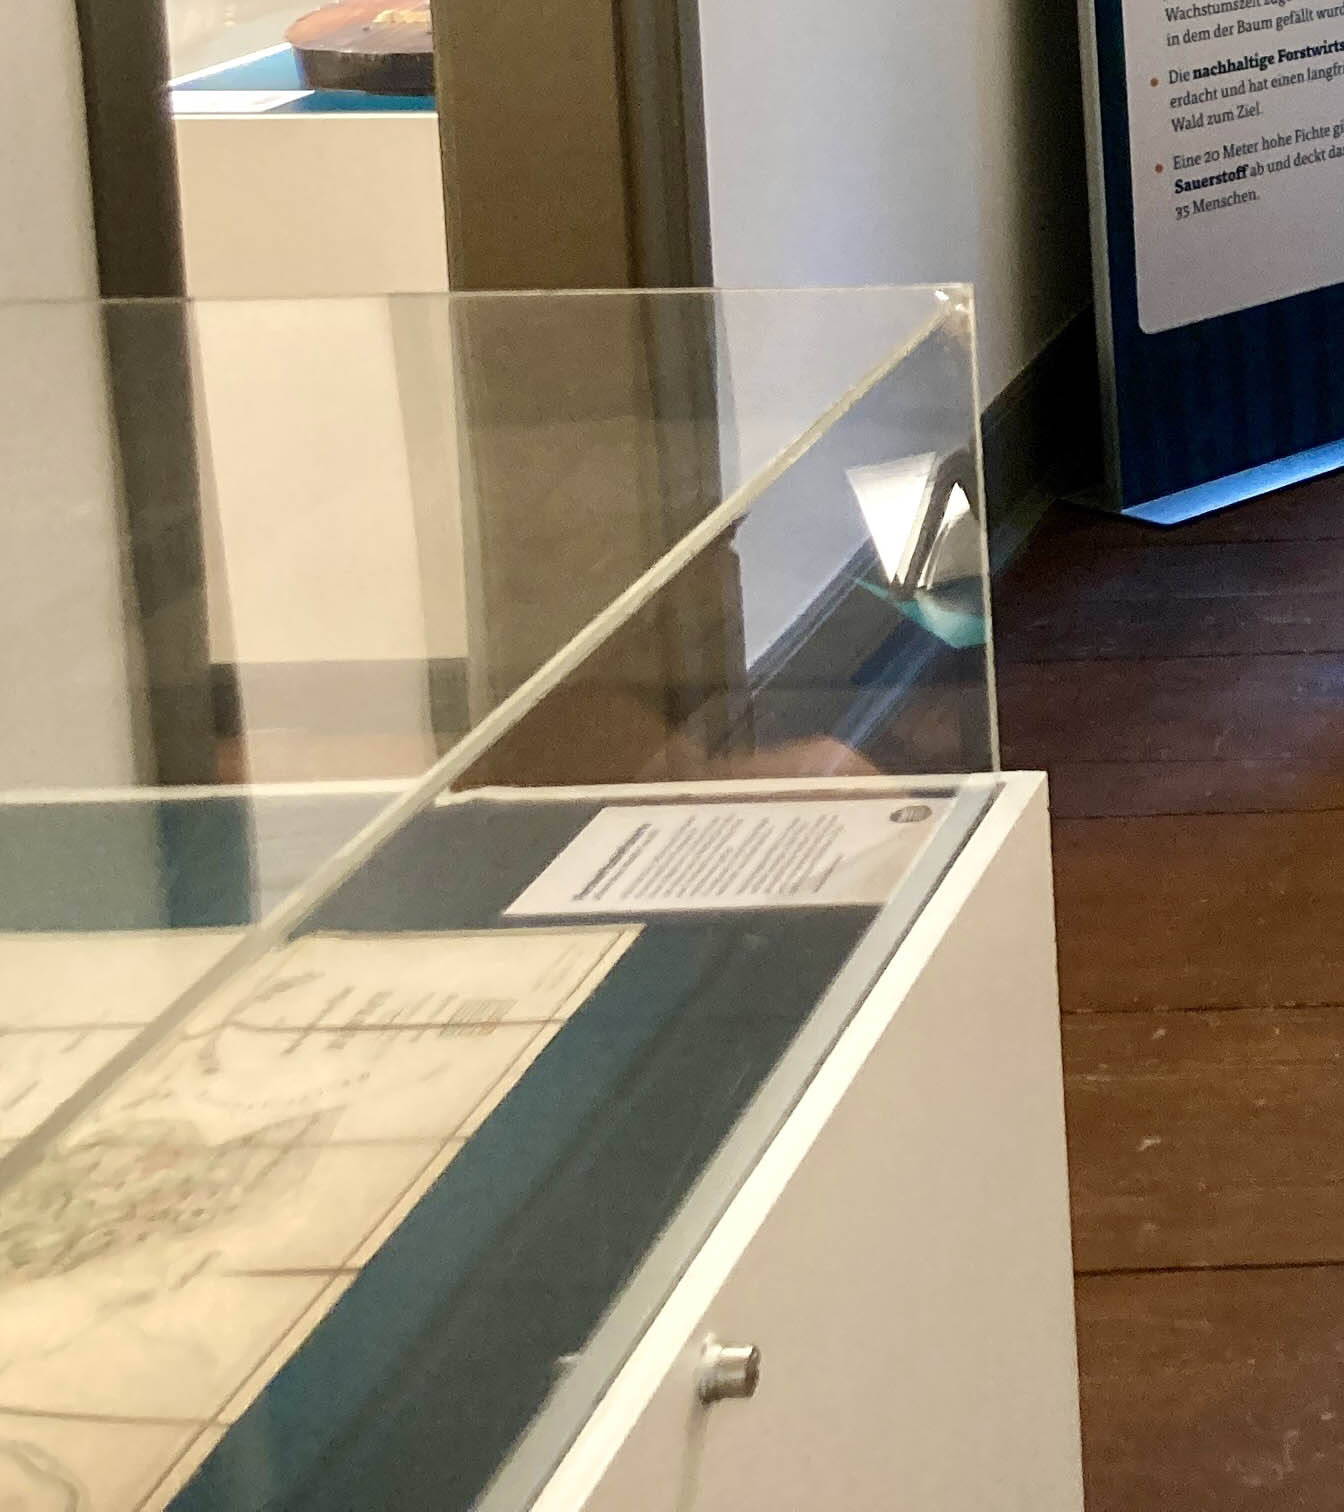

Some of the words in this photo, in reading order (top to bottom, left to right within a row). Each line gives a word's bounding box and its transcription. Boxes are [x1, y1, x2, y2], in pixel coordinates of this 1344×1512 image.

[1167, 33, 1179, 46] in
[1183, 29, 1210, 44] dem
[1214, 24, 1234, 40] der
[1237, 19, 1272, 34] Baum
[1169, 70, 1190, 85] Die
[1193, 52, 1274, 80] nachhaltige
[1170, 89, 1217, 108] erdacht
[1221, 81, 1246, 98] und
[1249, 79, 1269, 93] hat
[1272, 73, 1304, 87] einen
[1172, 114, 1204, 132] Wald
[1207, 109, 1234, 125] zum
[1173, 155, 1201, 170] Eine
[1223, 142, 1259, 159] Meter
[1262, 135, 1292, 150] hohe
[1295, 126, 1330, 144] Fichte
[1174, 164, 1249, 193] Sauerstoff
[1250, 163, 1264, 176] ab
[1268, 159, 1291, 172] und
[1294, 149, 1326, 167] deckt
[1175, 206, 1189, 220] 35
